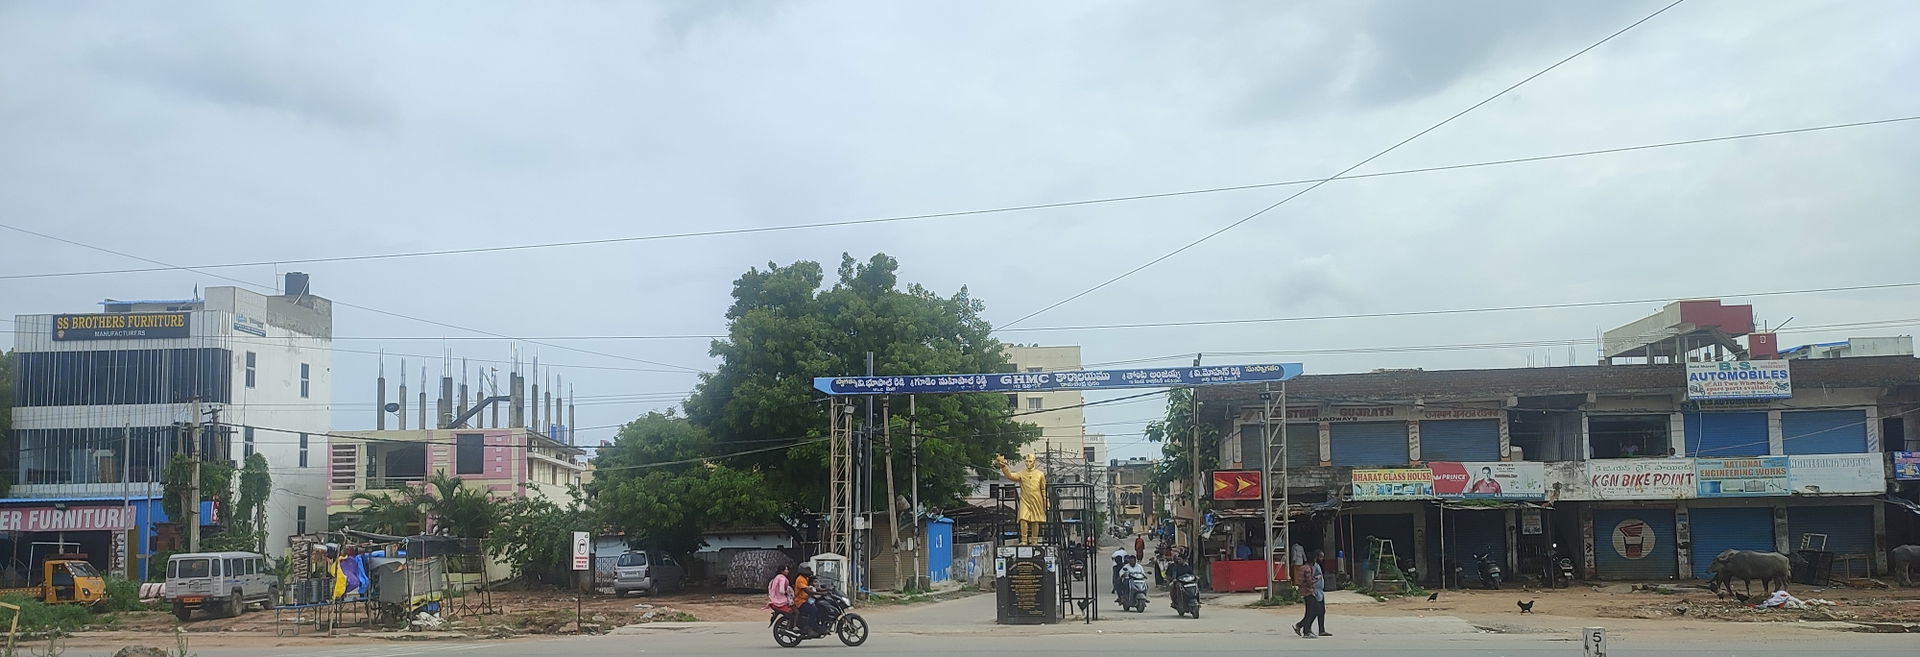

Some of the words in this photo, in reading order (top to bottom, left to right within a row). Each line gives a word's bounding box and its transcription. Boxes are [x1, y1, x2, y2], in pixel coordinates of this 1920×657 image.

[57, 317, 69, 329] SS
[72, 316, 125, 329] BROTHERS
[128, 314, 185, 327] FURNITURE
[1719, 361, 1757, 371] B.S.
[1000, 374, 1049, 385] GHMC
[1689, 370, 1788, 381] AUTOMOBILES
[1340, 407, 1394, 417] GUJRATH
[1723, 460, 1763, 468] NATIONAL
[1353, 473, 1382, 481] BHARAT
[1383, 472, 1406, 481] GLASS
[1407, 472, 1432, 480] HOUSE
[1700, 467, 1754, 477] ENGINEERING
[1755, 467, 1787, 476] WORKS
[1591, 474, 1620, 487] KGN
[1622, 472, 1651, 487] BIKE
[1652, 472, 1695, 486] POINT
[1593, 632, 1601, 642] 5
